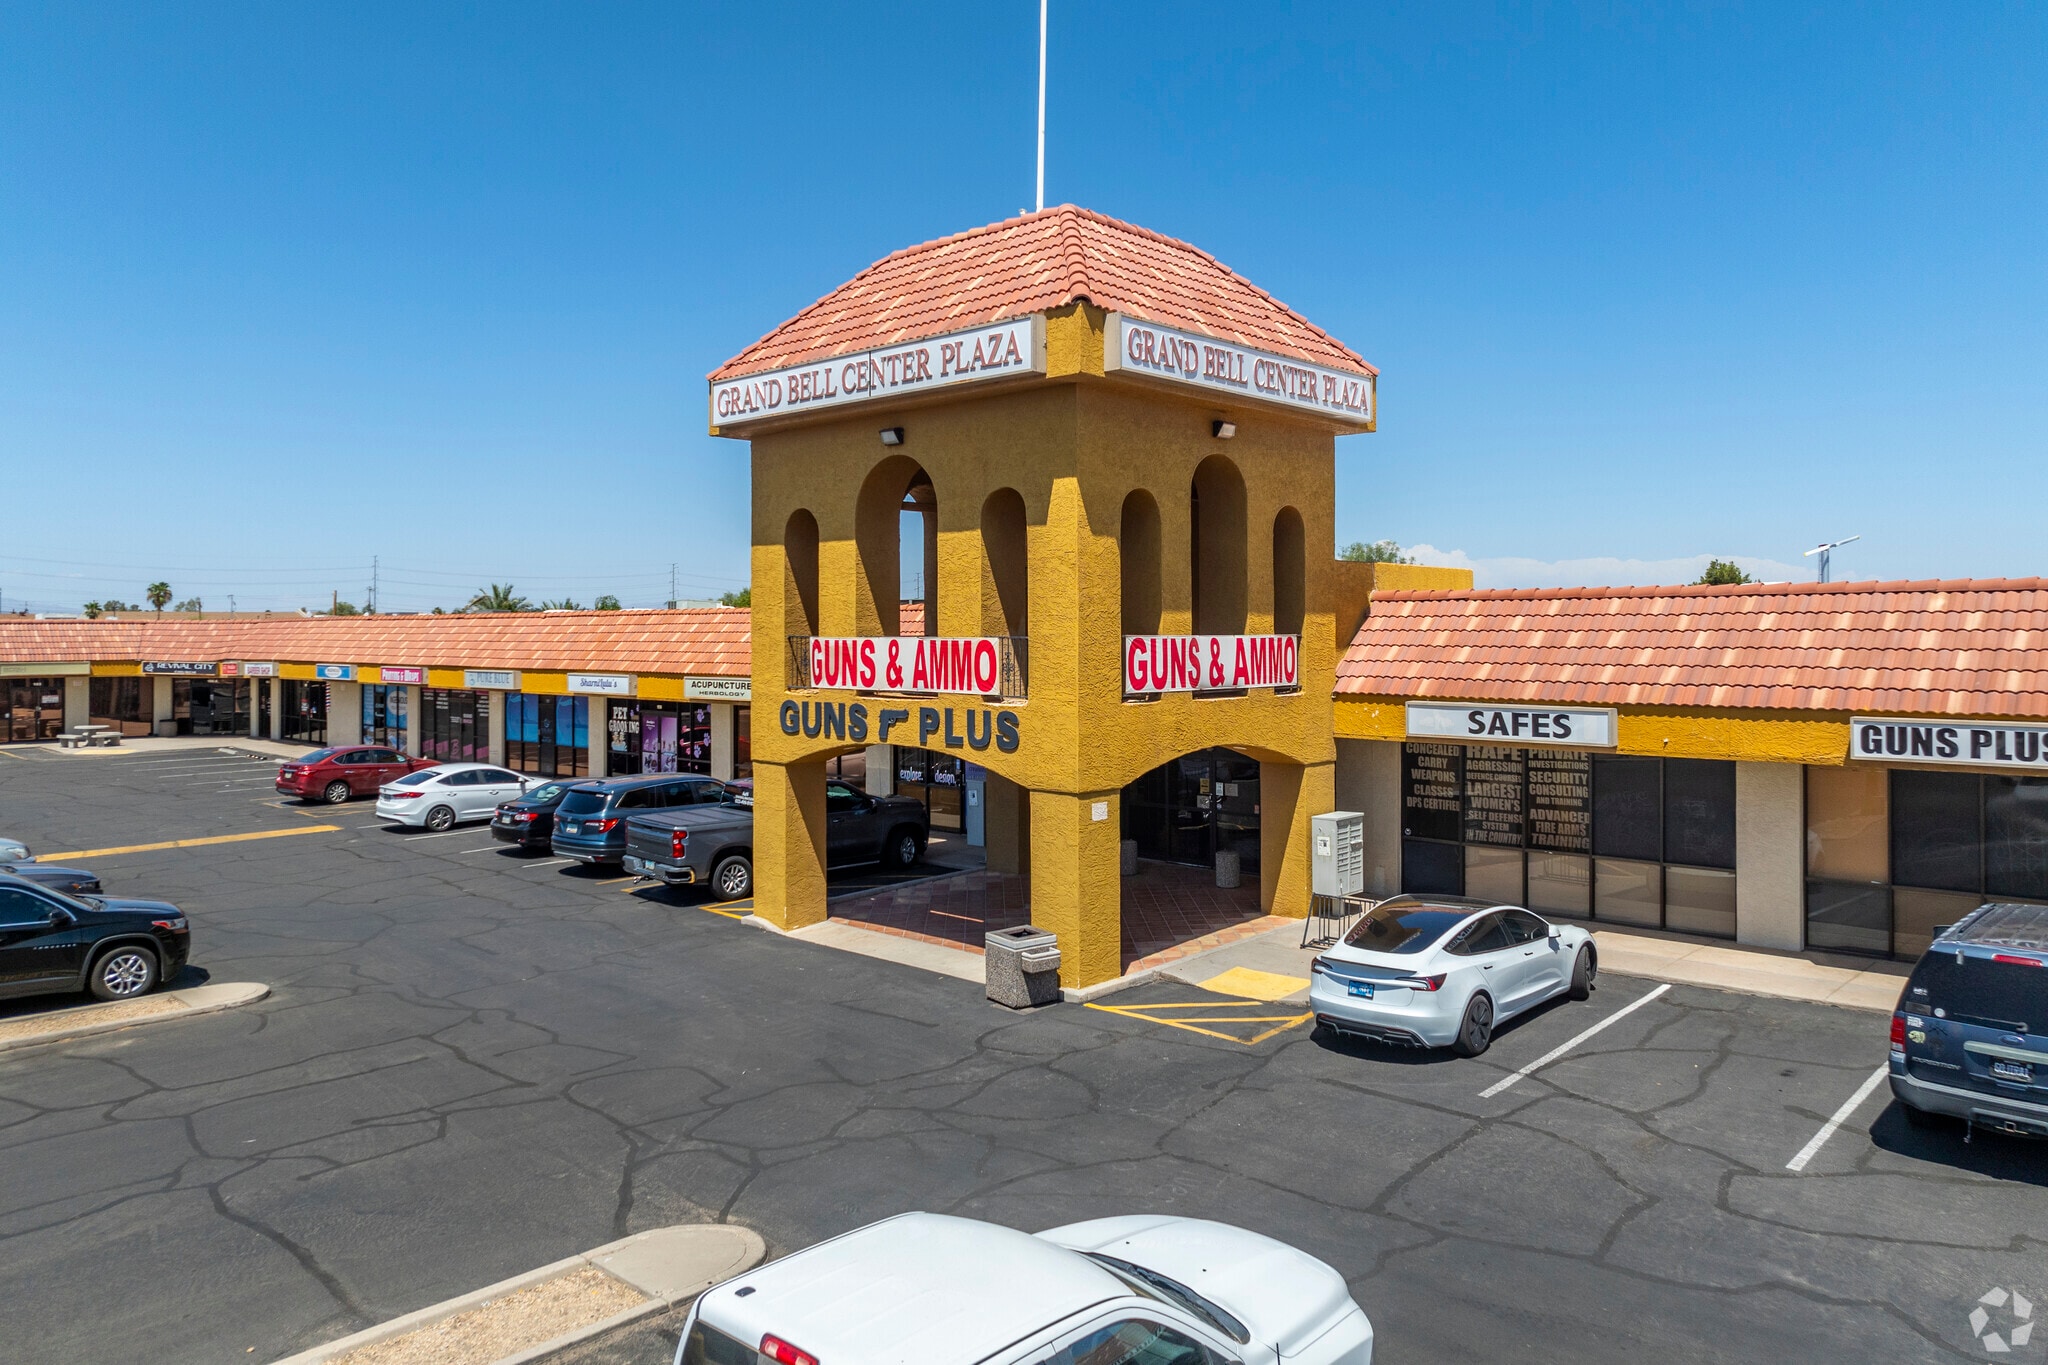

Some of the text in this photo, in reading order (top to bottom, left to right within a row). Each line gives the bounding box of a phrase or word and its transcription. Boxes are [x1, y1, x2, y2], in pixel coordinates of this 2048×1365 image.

[717, 329, 1023, 417] GRAND BELL CENTER PLAZA
[1127, 326, 1369, 412] GRAND BELL CENTER PLAZA
[811, 638, 998, 693] GUNS & AMMO
[1128, 636, 1296, 691] GUNS & AMMO
[691, 680, 751, 691] ACUPUNCTURE
[612, 706, 628, 720] PET
[780, 699, 1020, 752] GUNS PLUS
[1467, 710, 1572, 739] SAFES
[1406, 743, 1460, 757] CONCEALED
[1860, 724, 2048, 763] GUNS PLU
[1466, 745, 1522, 761] RAPE
[1528, 748, 1588, 761] PRIVATE
[1417, 756, 1448, 769] CARRY
[1466, 760, 1522, 773] AGGRESSION
[1528, 760, 1589, 770] INVESTIGATIONS
[1411, 769, 1456, 783] WEAPONS
[1529, 771, 1588, 785] SECURITY
[1413, 784, 1454, 798] CLASSES
[1467, 782, 1522, 800] LARGEST
[1529, 784, 1589, 798] CONSULTING
[1406, 797, 1423, 808] DPS
[1471, 797, 1521, 812] WOMEN'S
[1536, 797, 1583, 807] AND TRAINING
[1468, 810, 1487, 821] SELF
[1529, 808, 1590, 824] ADVANCED
[1482, 821, 1510, 831] SYSTEM
[1535, 821, 1587, 836] FIRE ARMS
[1475, 830, 1488, 842] THE
[1531, 833, 1590, 849] TRAINING
